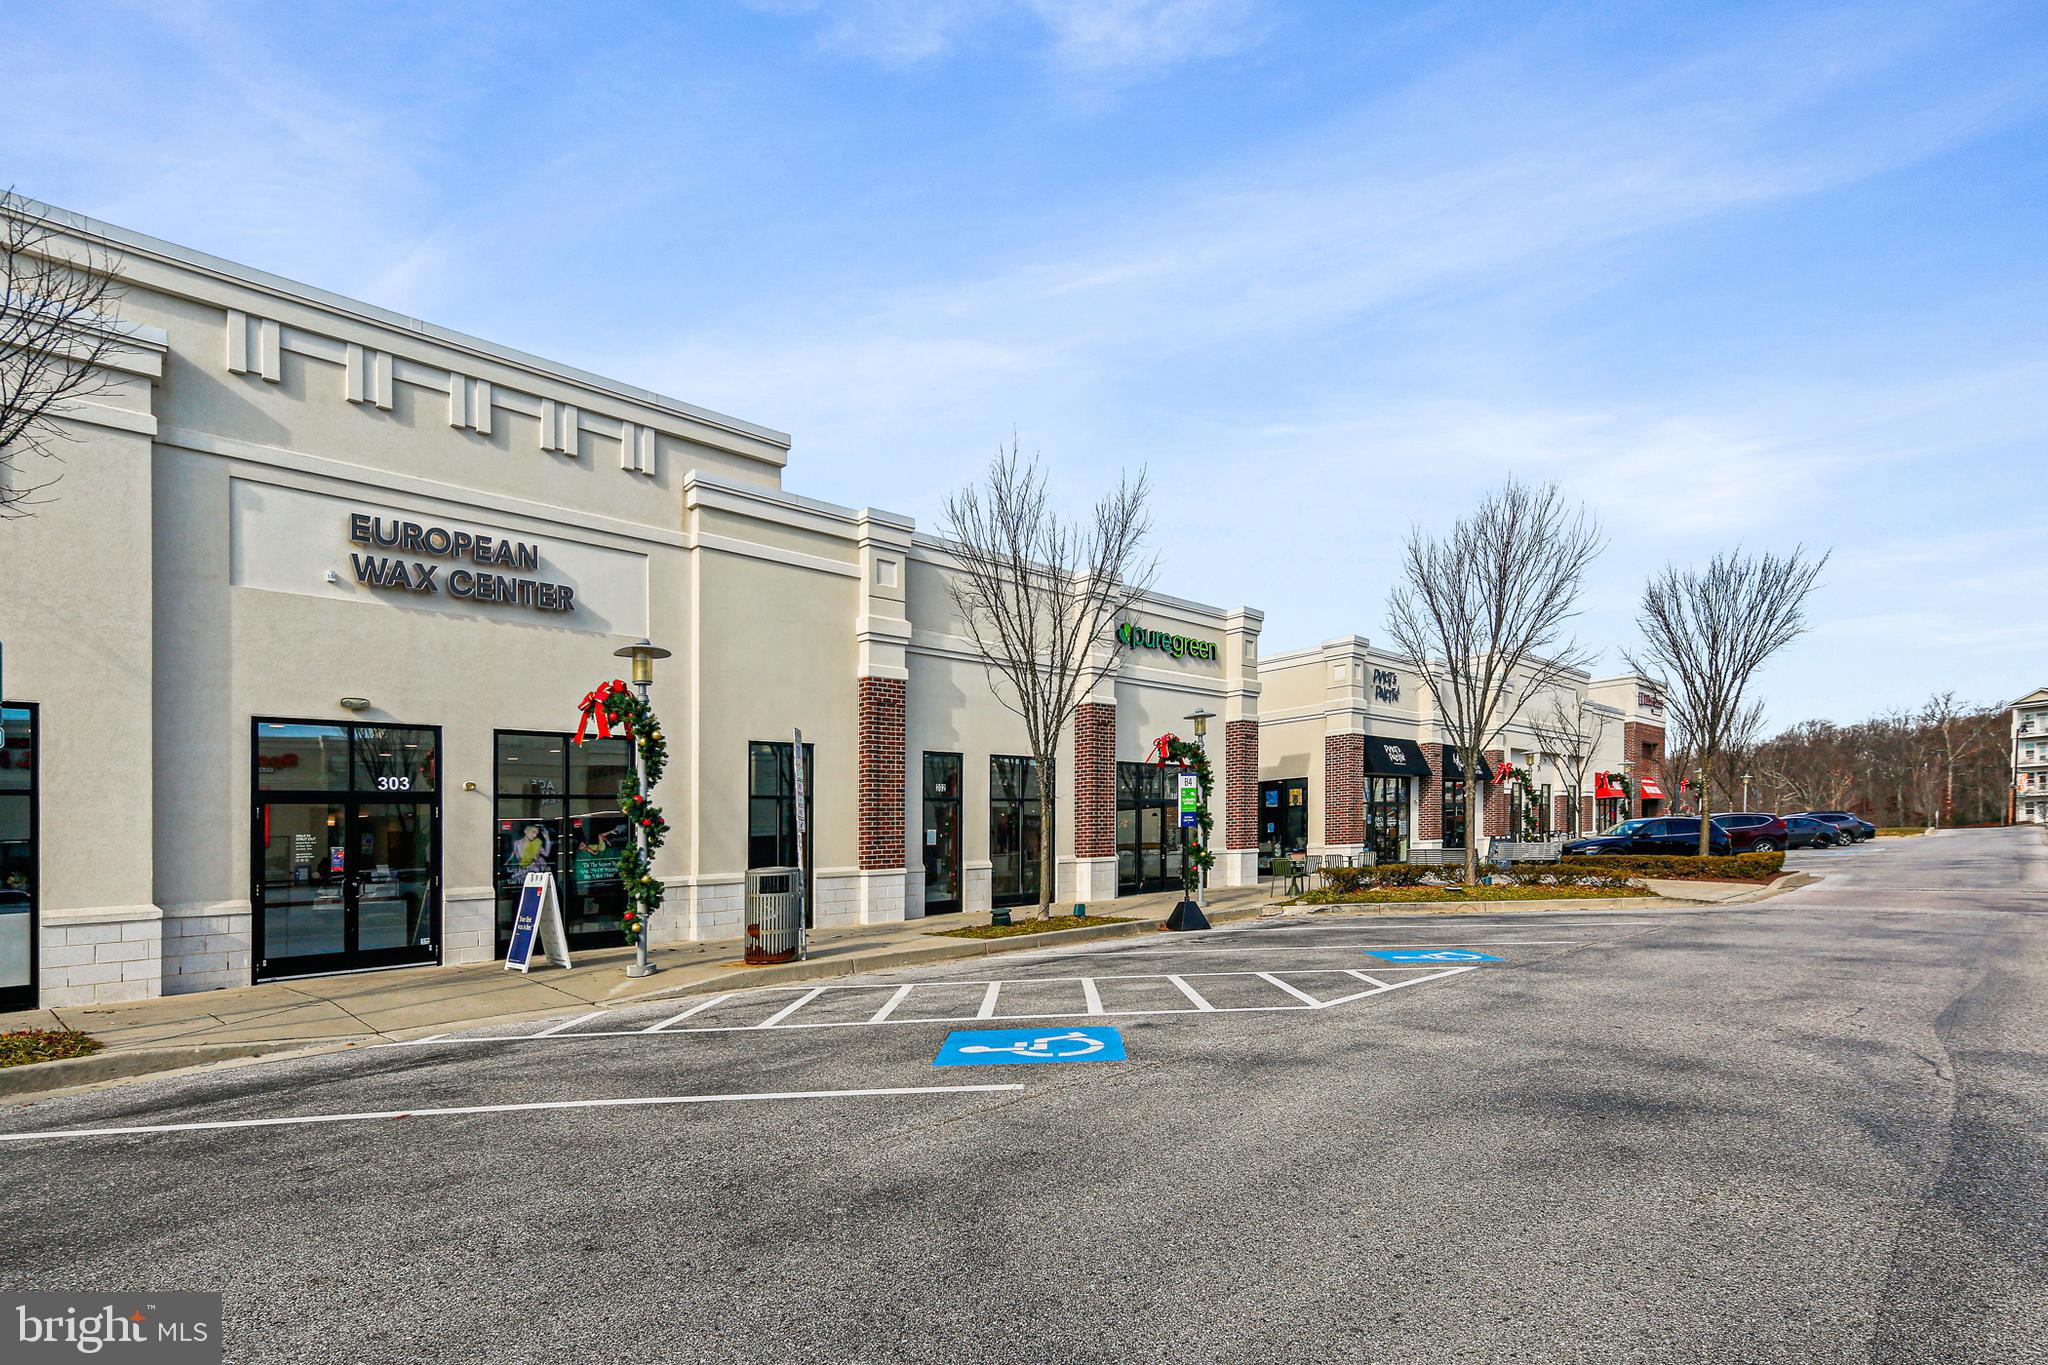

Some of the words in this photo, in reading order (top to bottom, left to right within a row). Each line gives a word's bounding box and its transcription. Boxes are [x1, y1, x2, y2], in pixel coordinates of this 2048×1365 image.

[350, 512, 540, 571] EUROPEAN
[350, 552, 440, 593] WAX
[448, 569, 576, 611] CENTER
[377, 776, 410, 791] 303
[1184, 777, 1193, 787] B4
